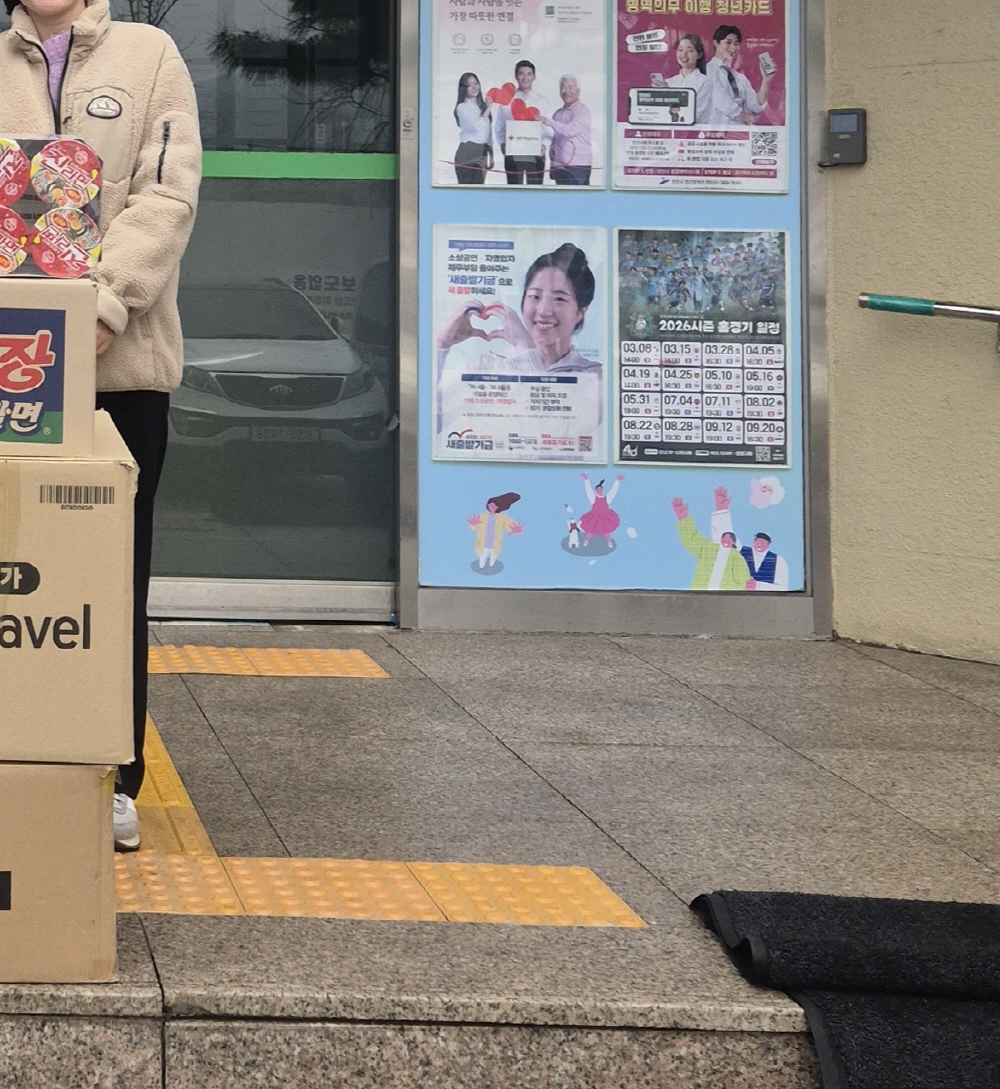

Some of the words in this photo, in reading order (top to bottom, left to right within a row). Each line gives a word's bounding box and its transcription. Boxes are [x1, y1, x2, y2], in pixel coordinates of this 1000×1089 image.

[684, 0, 712, 14] 이행
[716, 0, 772, 15] 청년카드
[449, 11, 467, 22] 가장
[469, 11, 495, 22] 따뜻한
[496, 11, 514, 22] 연결
[40, 148, 93, 191] 진라면
[448, 254, 478, 262] 소상공인
[484, 254, 516, 263] 자영업자
[448, 263, 478, 272] 채무부담
[658, 319, 716, 333] 2026시즌
[717, 320, 754, 333] 홈경기
[756, 321, 781, 335] 일정
[623, 343, 651, 353] 03.08
[664, 344, 691, 354] 03.15
[705, 345, 733, 355] 03.28
[746, 345, 775, 355] 04.05
[623, 369, 650, 378] 04.19
[664, 369, 692, 379] 04.25
[705, 370, 732, 380] 05.10
[746, 371, 773, 381] 05.16
[623, 394, 650, 404] 05.31
[664, 395, 693, 405] 07.04
[705, 396, 731, 406] 07.11
[746, 397, 775, 407] 08.02
[623, 420, 652, 430] 08.22
[664, 421, 693, 431] 08.28
[705, 422, 732, 432] 09.12
[746, 423, 775, 432] 09.20
[446, 439, 494, 451] 새출발기금
